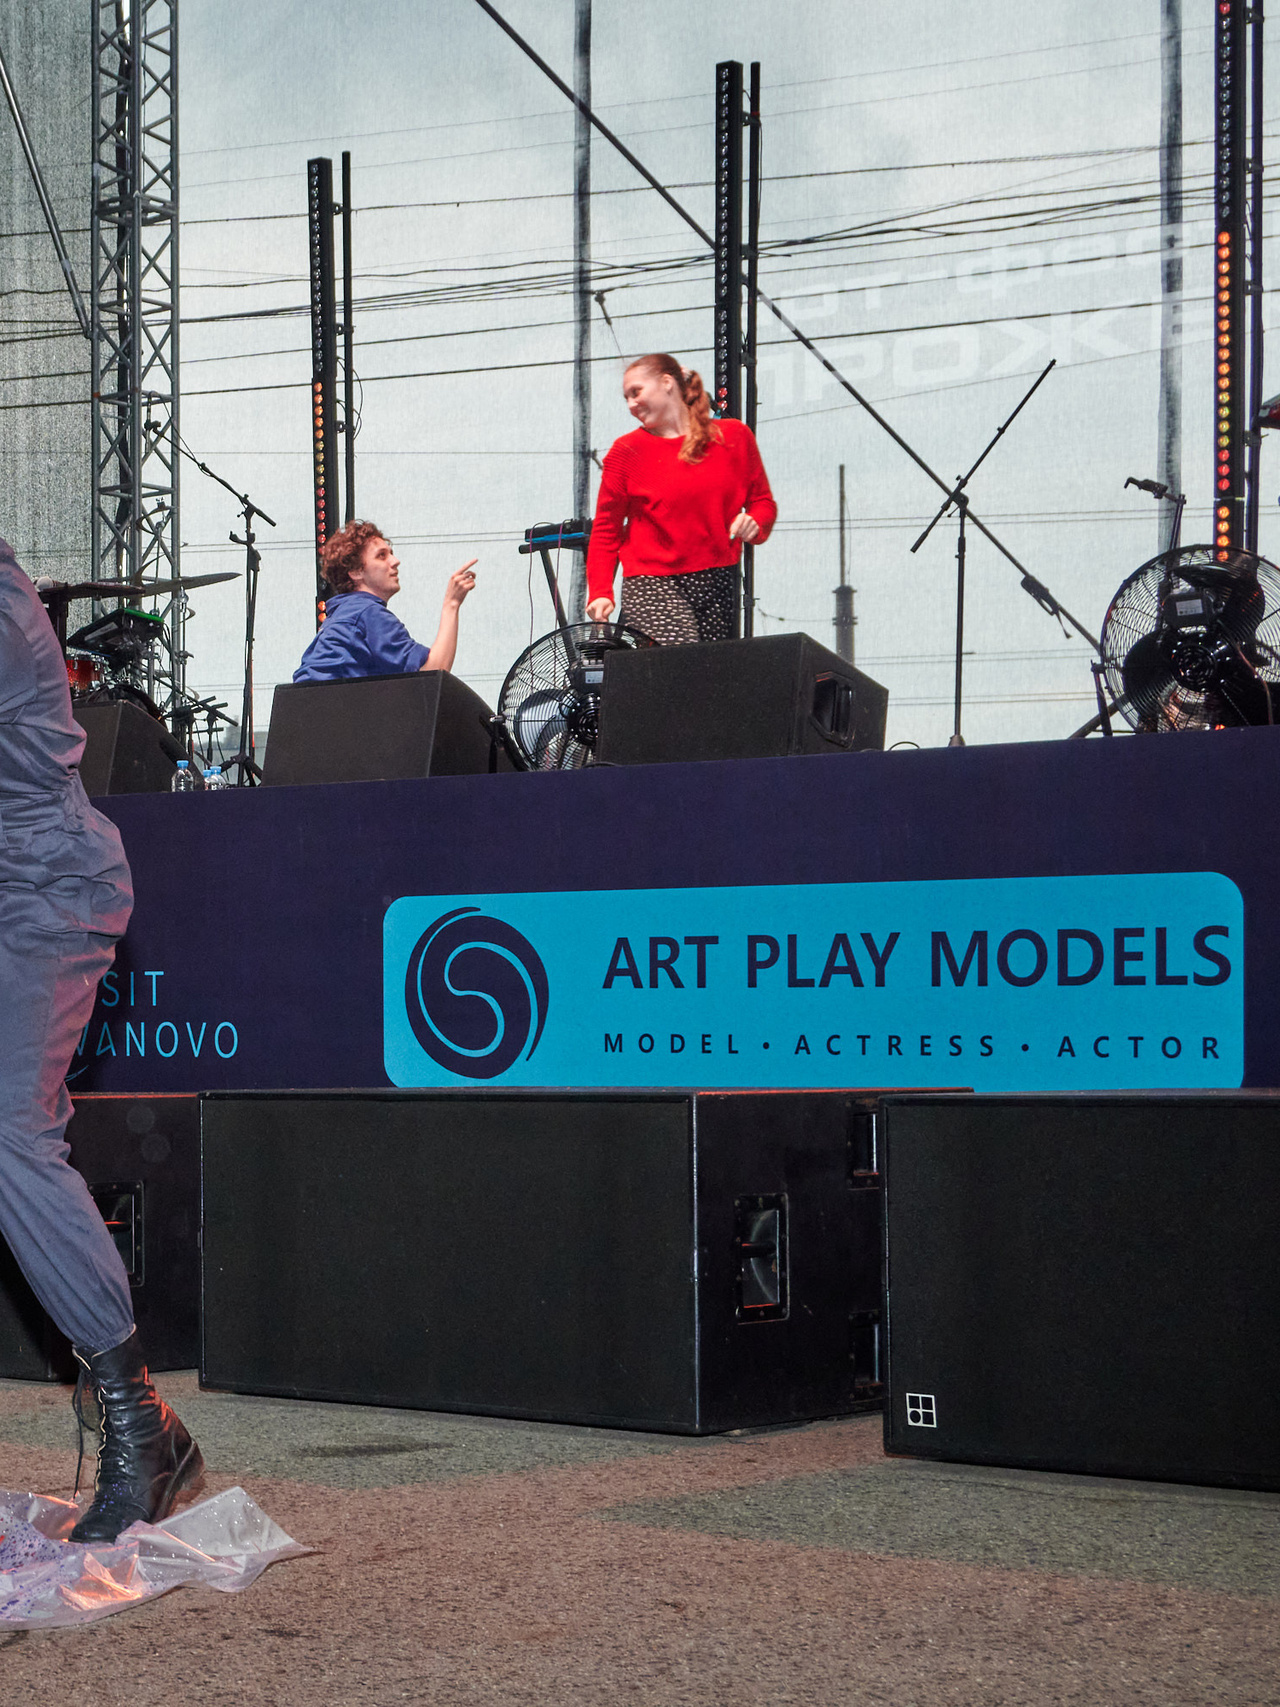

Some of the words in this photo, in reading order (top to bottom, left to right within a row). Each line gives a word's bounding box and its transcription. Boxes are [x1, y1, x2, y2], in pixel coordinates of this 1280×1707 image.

[602, 936, 719, 989] ART
[747, 932, 901, 988] PLAY
[931, 925, 1232, 987] MODELS
[604, 1033, 739, 1055] MODEL
[795, 1034, 994, 1057] ACTRESS
[1057, 1036, 1220, 1060] ACTOR
